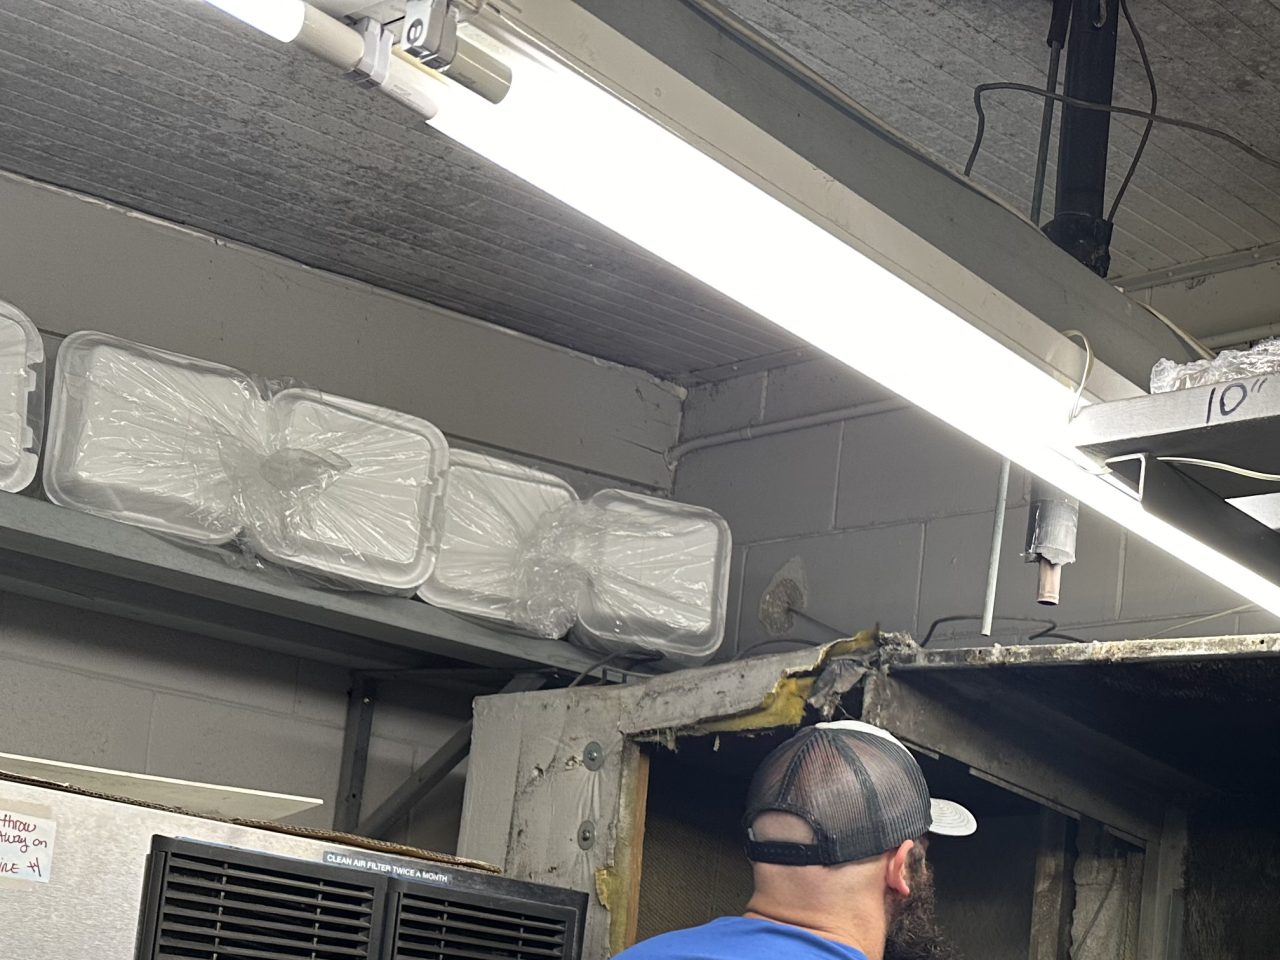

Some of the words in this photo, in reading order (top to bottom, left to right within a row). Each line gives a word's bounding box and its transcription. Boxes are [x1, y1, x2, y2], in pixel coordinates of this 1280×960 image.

[32, 838, 48, 849] on
[326, 853, 352, 866] CLEAN
[352, 858, 367, 868] AIR
[366, 861, 392, 873] FILTER
[391, 865, 415, 877] TWICE
[422, 871, 448, 883] MONTH
